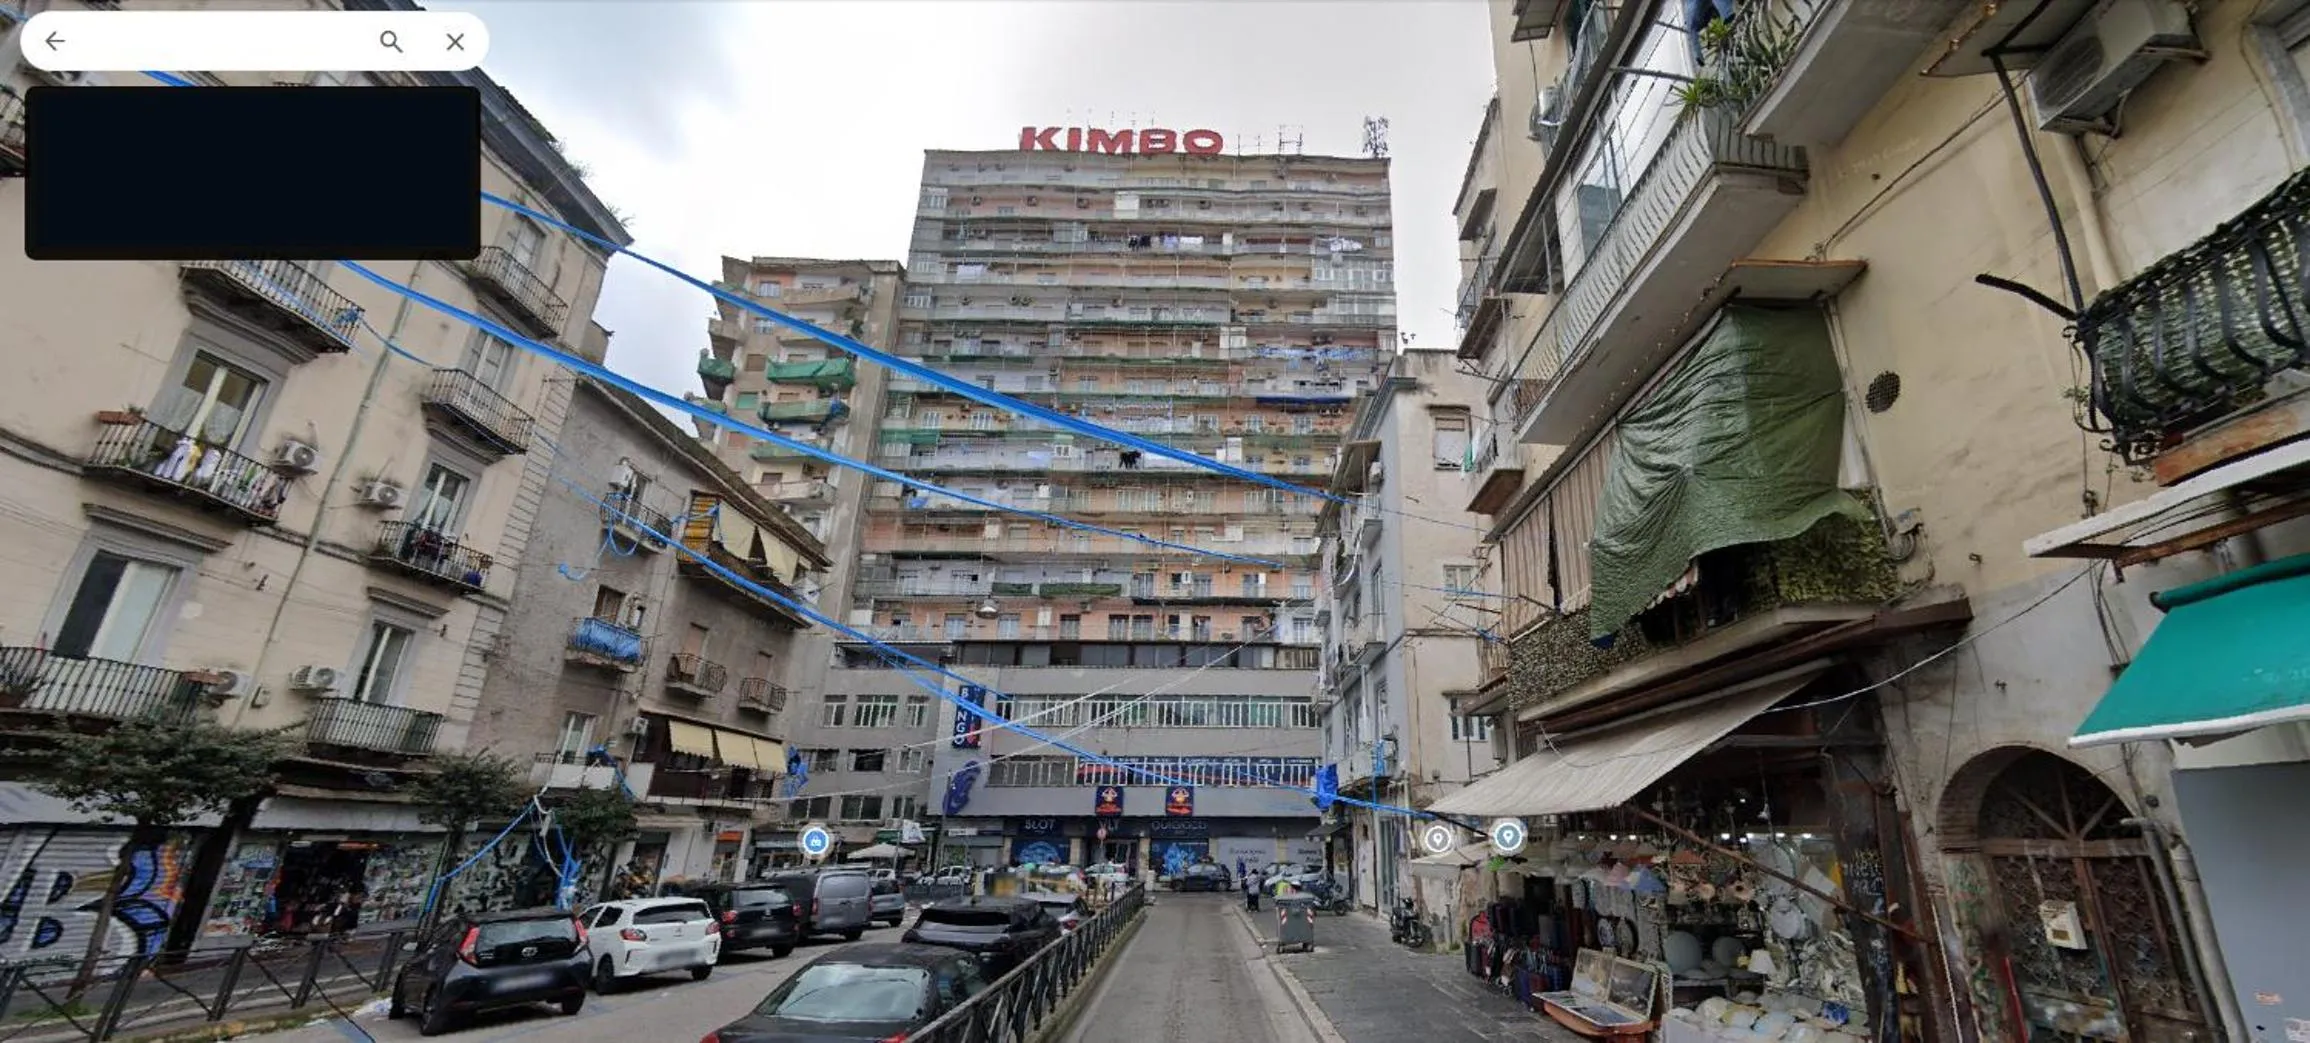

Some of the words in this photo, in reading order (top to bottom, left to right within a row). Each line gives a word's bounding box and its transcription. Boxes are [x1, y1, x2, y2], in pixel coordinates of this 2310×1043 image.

[1019, 127, 1223, 155] KIMBO
[954, 687, 969, 744] BNGO
[1025, 818, 1055, 830] SLOT
